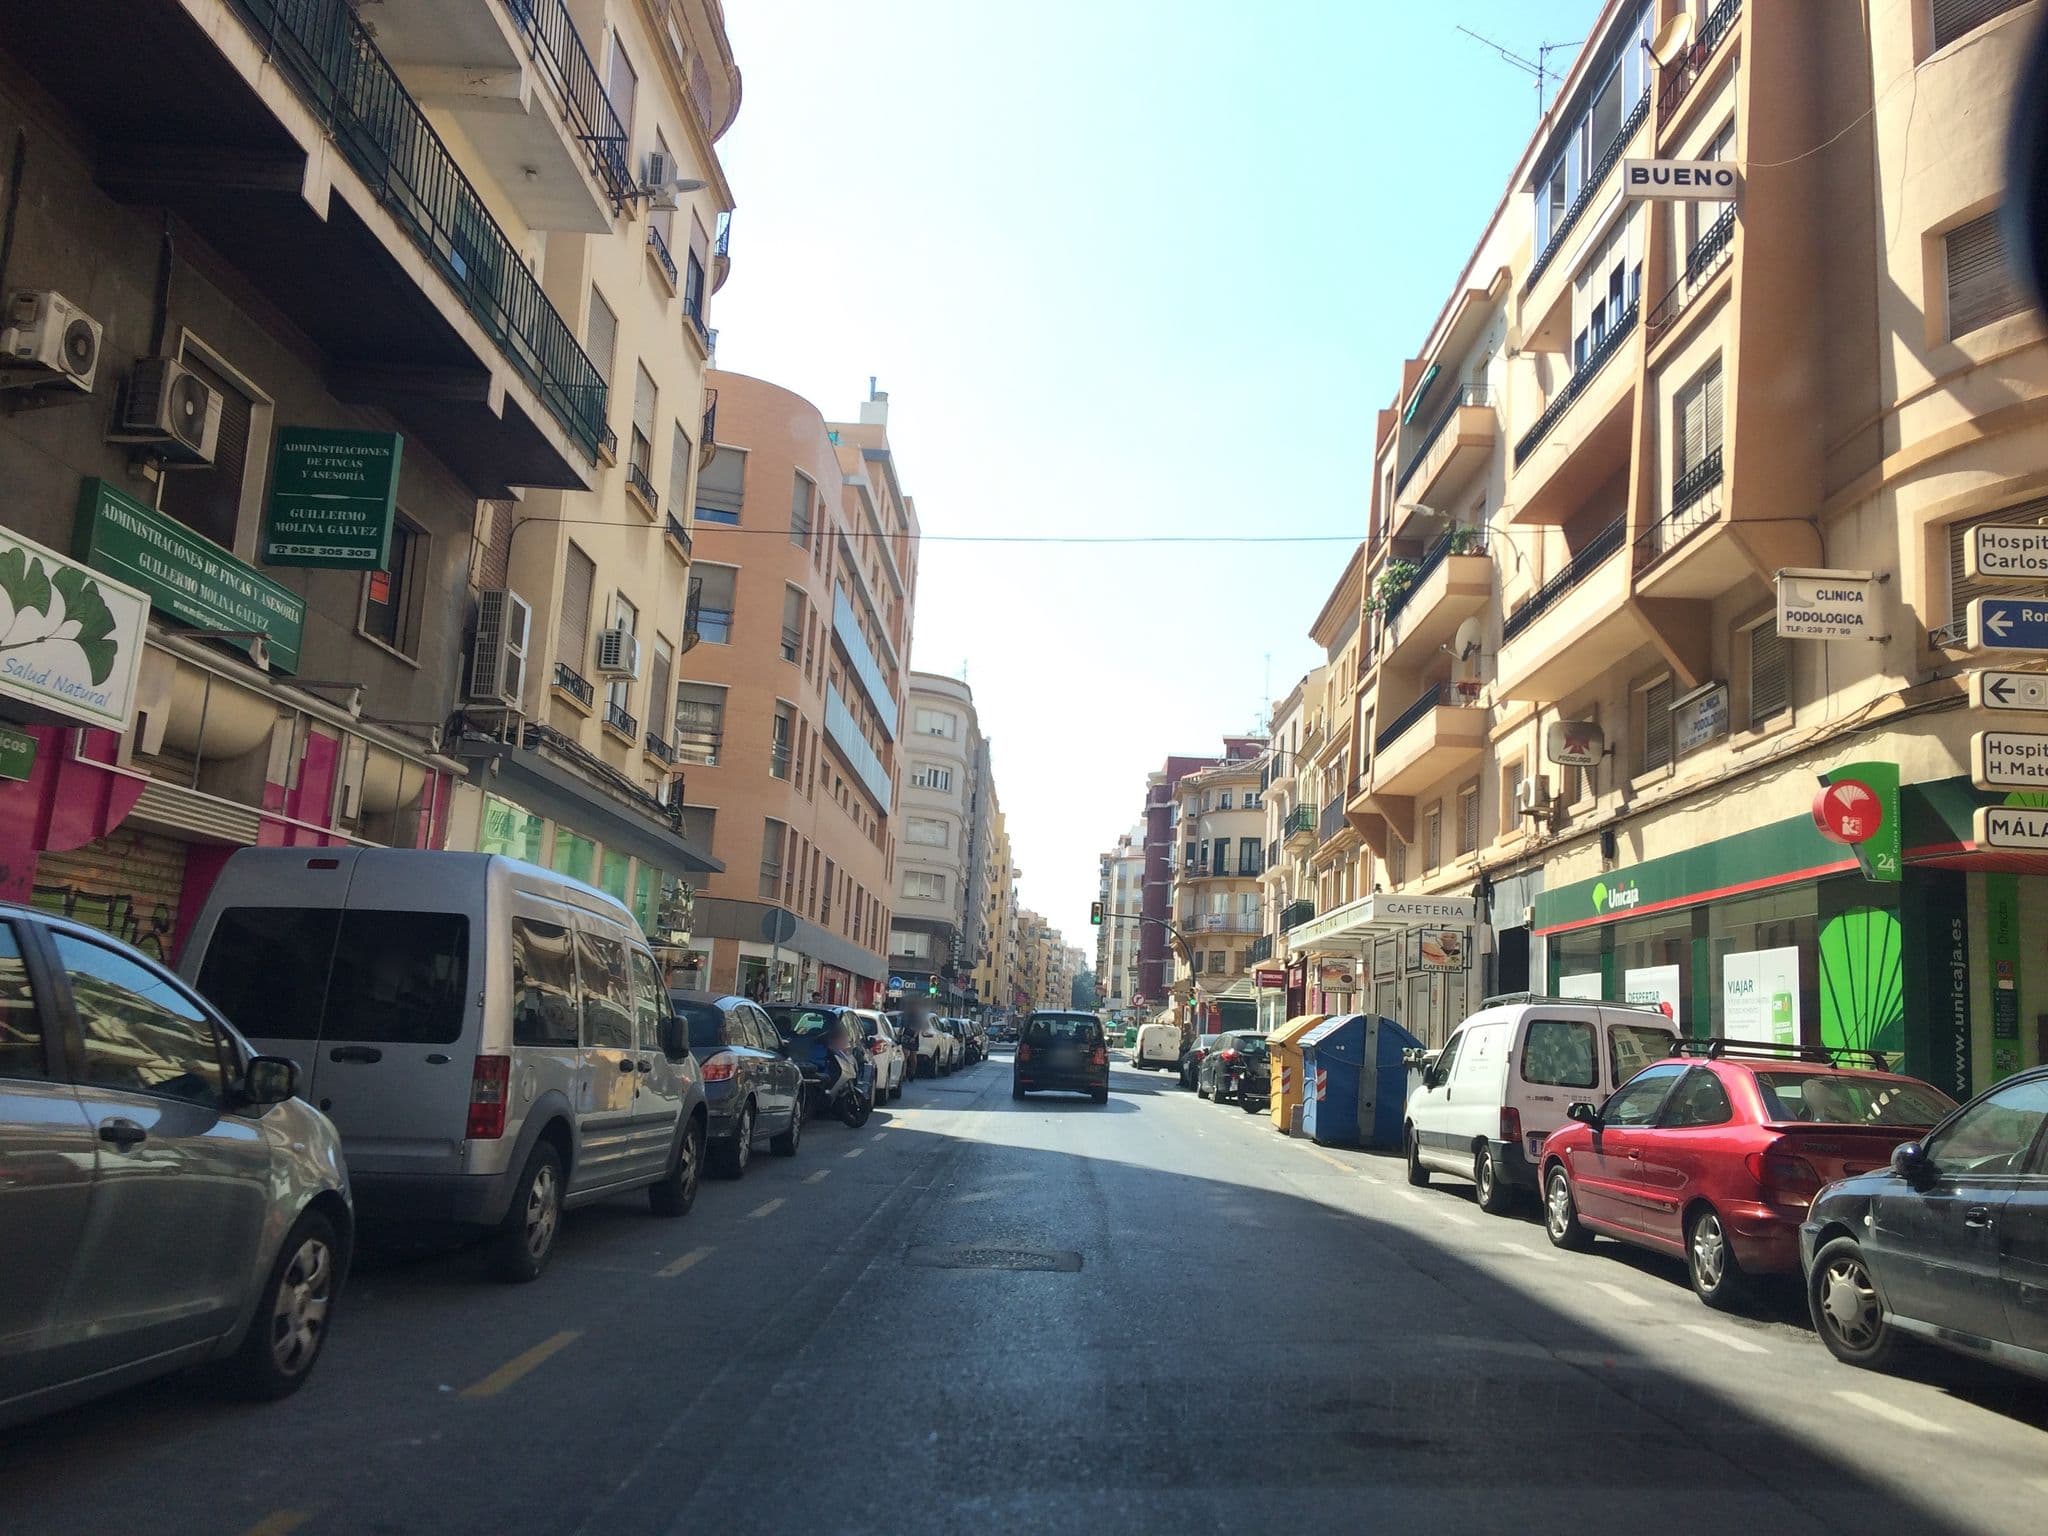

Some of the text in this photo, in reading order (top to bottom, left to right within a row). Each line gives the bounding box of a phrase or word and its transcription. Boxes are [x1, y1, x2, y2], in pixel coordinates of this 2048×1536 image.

[1631, 167, 1733, 186] BUENO
[284, 443, 390, 456] ADMINISTRACIONES
[306, 457, 364, 468] DE FINCAS
[302, 470, 365, 481] Y ASESORÍA
[289, 508, 367, 521] GUILLERMO
[275, 522, 378, 537] MOLINA GÁLVEZ
[290, 546, 372, 557] 952 305 305
[101, 502, 300, 624] ADMINISTRACIONES DE FINCAS Y ASESORÍA
[1983, 553, 2048, 570] Carlos
[139, 552, 270, 632] GUILLERMO MOLINA GÁLVEZ
[1816, 589, 1863, 602] CLINICA
[1786, 610, 1863, 625] PODOLOGICA
[2022, 608, 2048, 622] Ro
[1786, 625, 1804, 633] TLF:
[2, 657, 112, 707] Salud Natural
[1877, 853, 1896, 873] 24
[1608, 880, 1639, 909] Unicaja
[1387, 903, 1464, 917] CAFETERIA
[1727, 979, 1754, 996] VIAJAR
[1950, 918, 1967, 1092] www.unicaja.es
